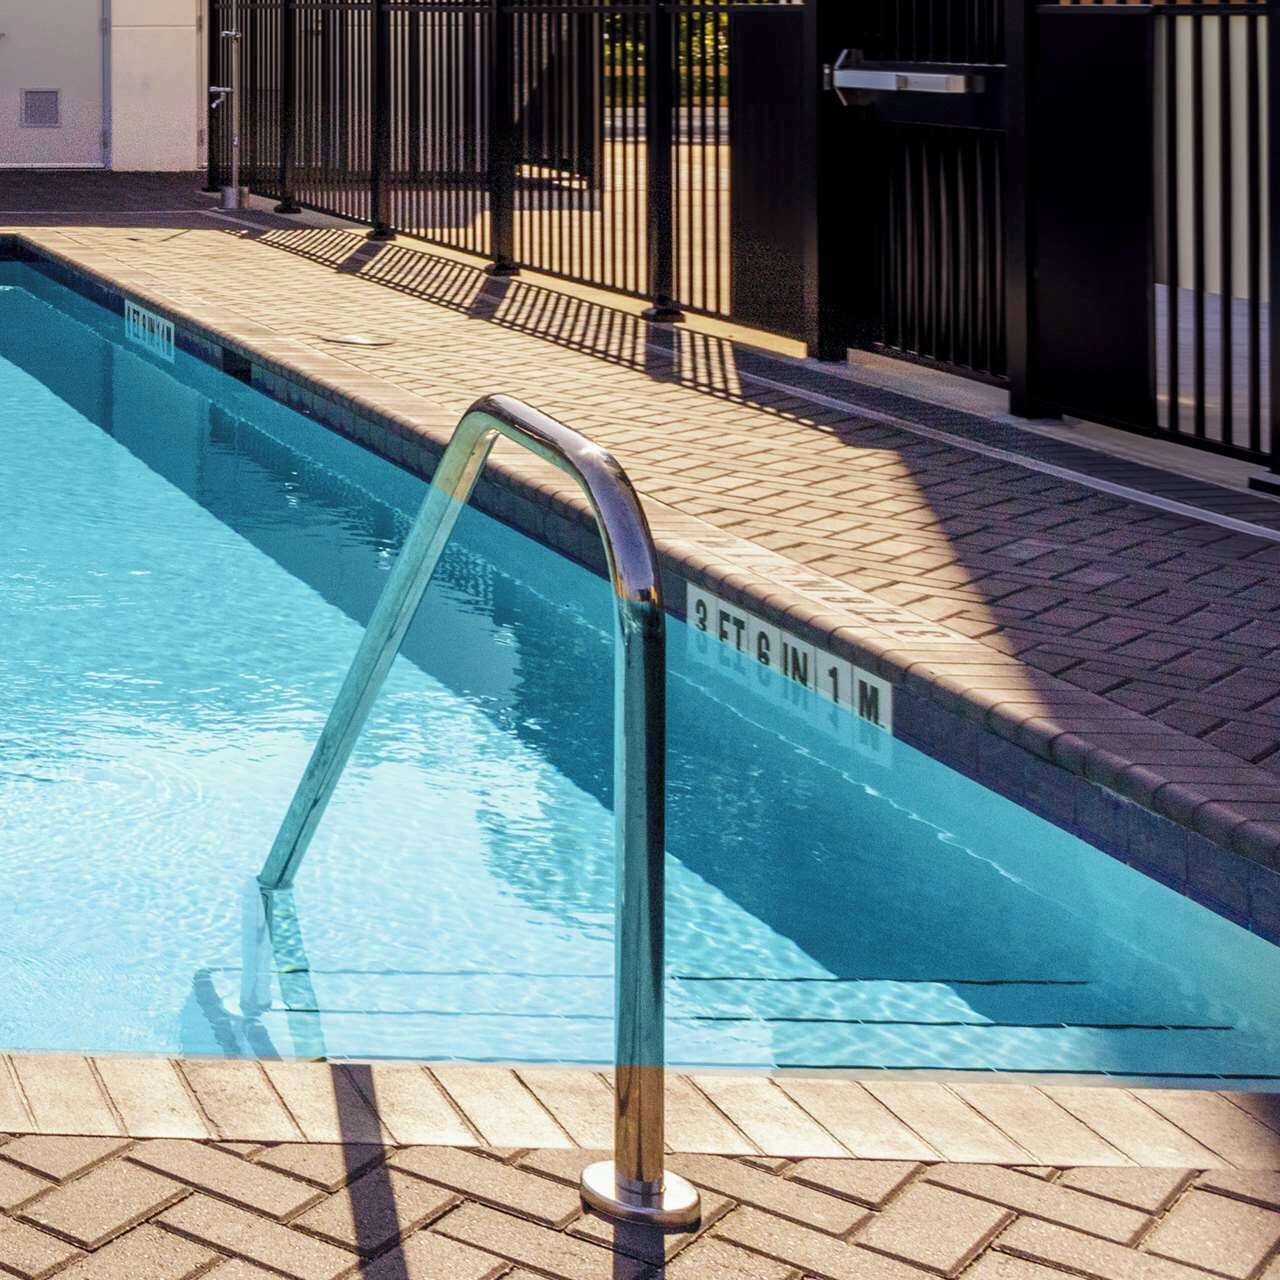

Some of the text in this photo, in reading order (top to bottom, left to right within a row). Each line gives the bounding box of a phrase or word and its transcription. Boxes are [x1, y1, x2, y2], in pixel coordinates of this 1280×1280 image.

[695, 599, 707, 632] 3
[757, 631, 770, 666] 6
[828, 666, 839, 705] 1
